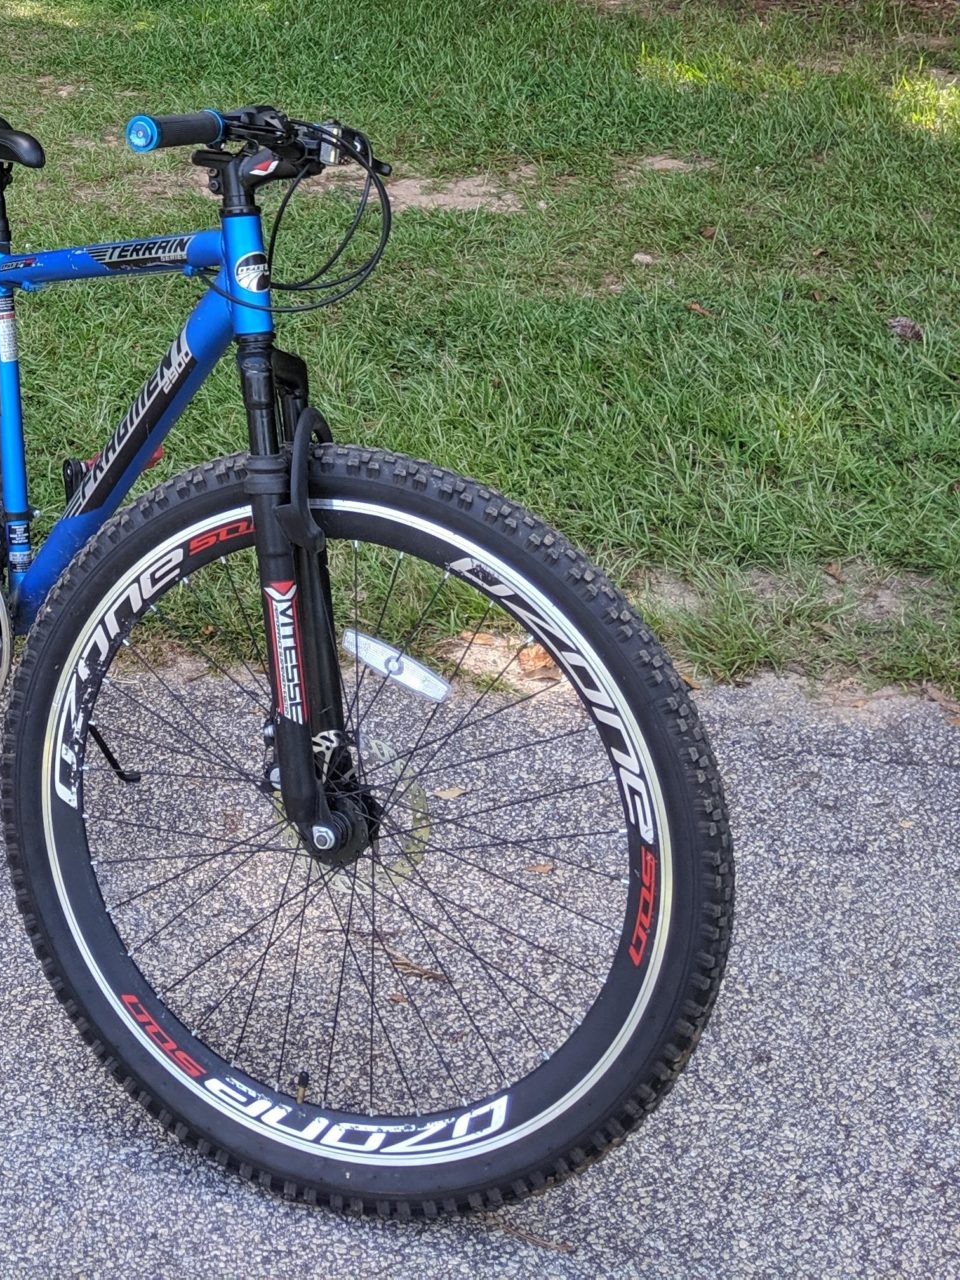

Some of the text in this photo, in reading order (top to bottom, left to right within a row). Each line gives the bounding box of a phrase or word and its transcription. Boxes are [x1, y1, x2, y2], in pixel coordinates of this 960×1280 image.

[108, 236, 192, 260] TERRAIN
[163, 348, 192, 394] 2900
[277, 602, 303, 724] VITESSE
